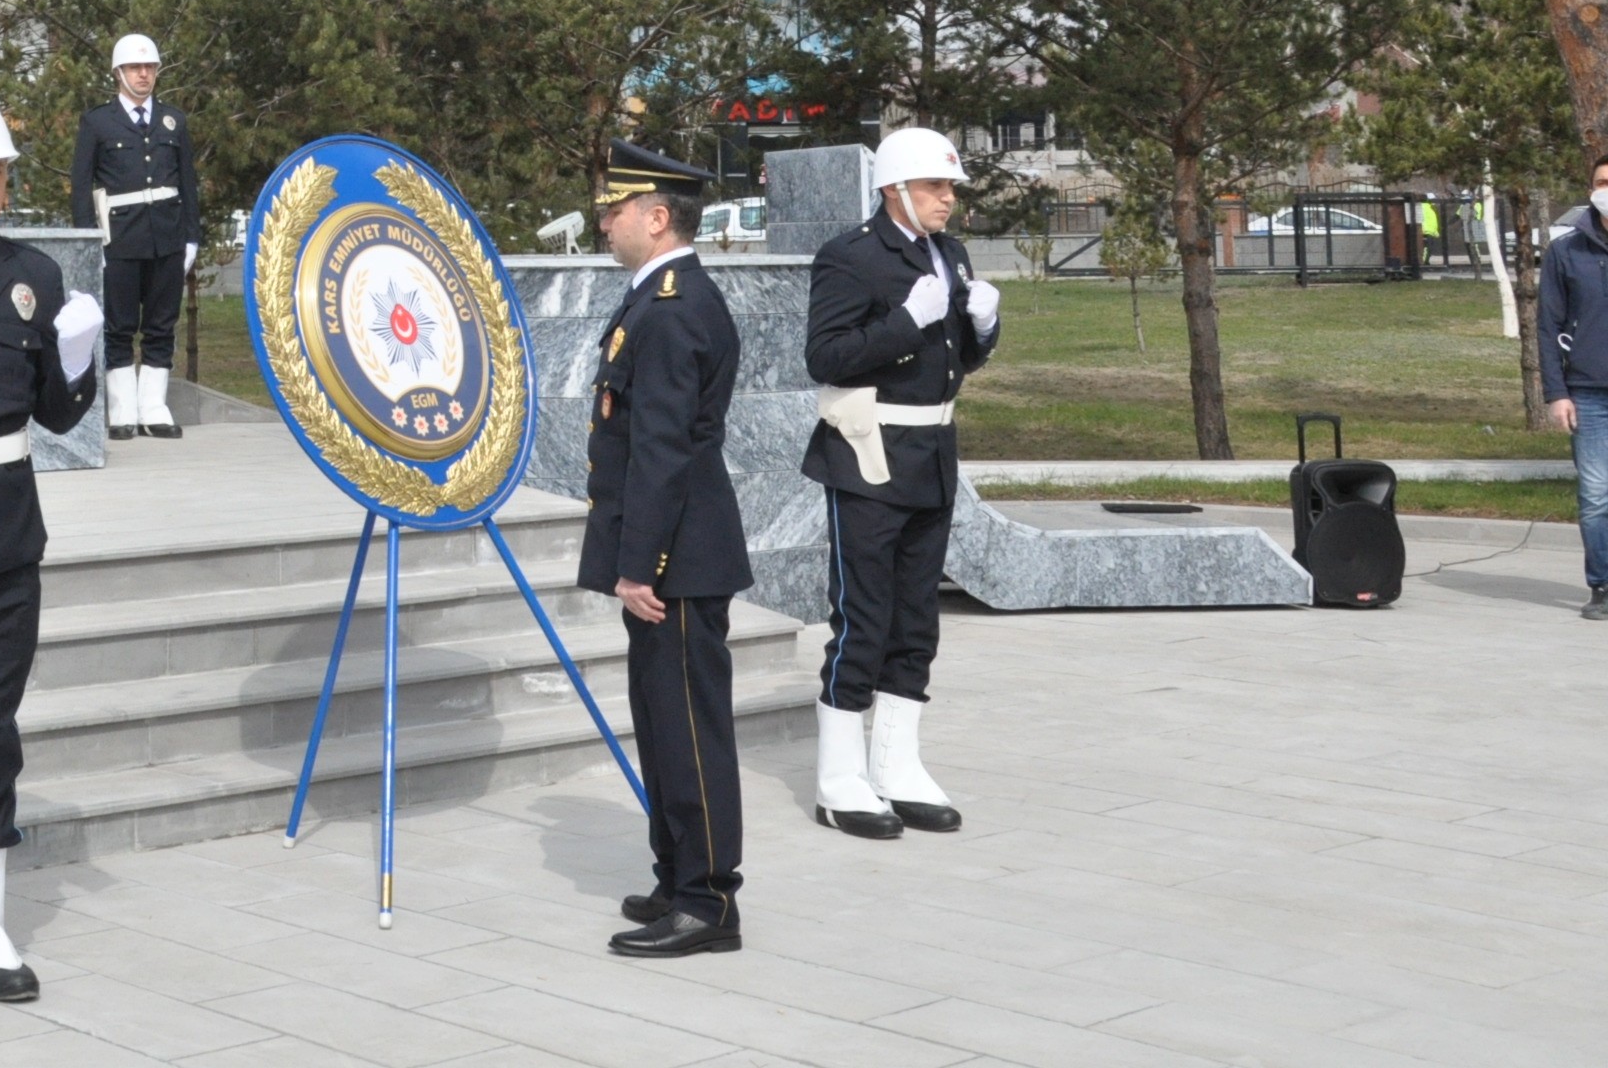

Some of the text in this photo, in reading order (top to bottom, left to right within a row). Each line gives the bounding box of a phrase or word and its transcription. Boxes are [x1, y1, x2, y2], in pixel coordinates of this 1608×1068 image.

[325, 223, 472, 334] KARS EMNİYET MÜDÜRLÜĞÜ
[410, 392, 439, 409] EGM
